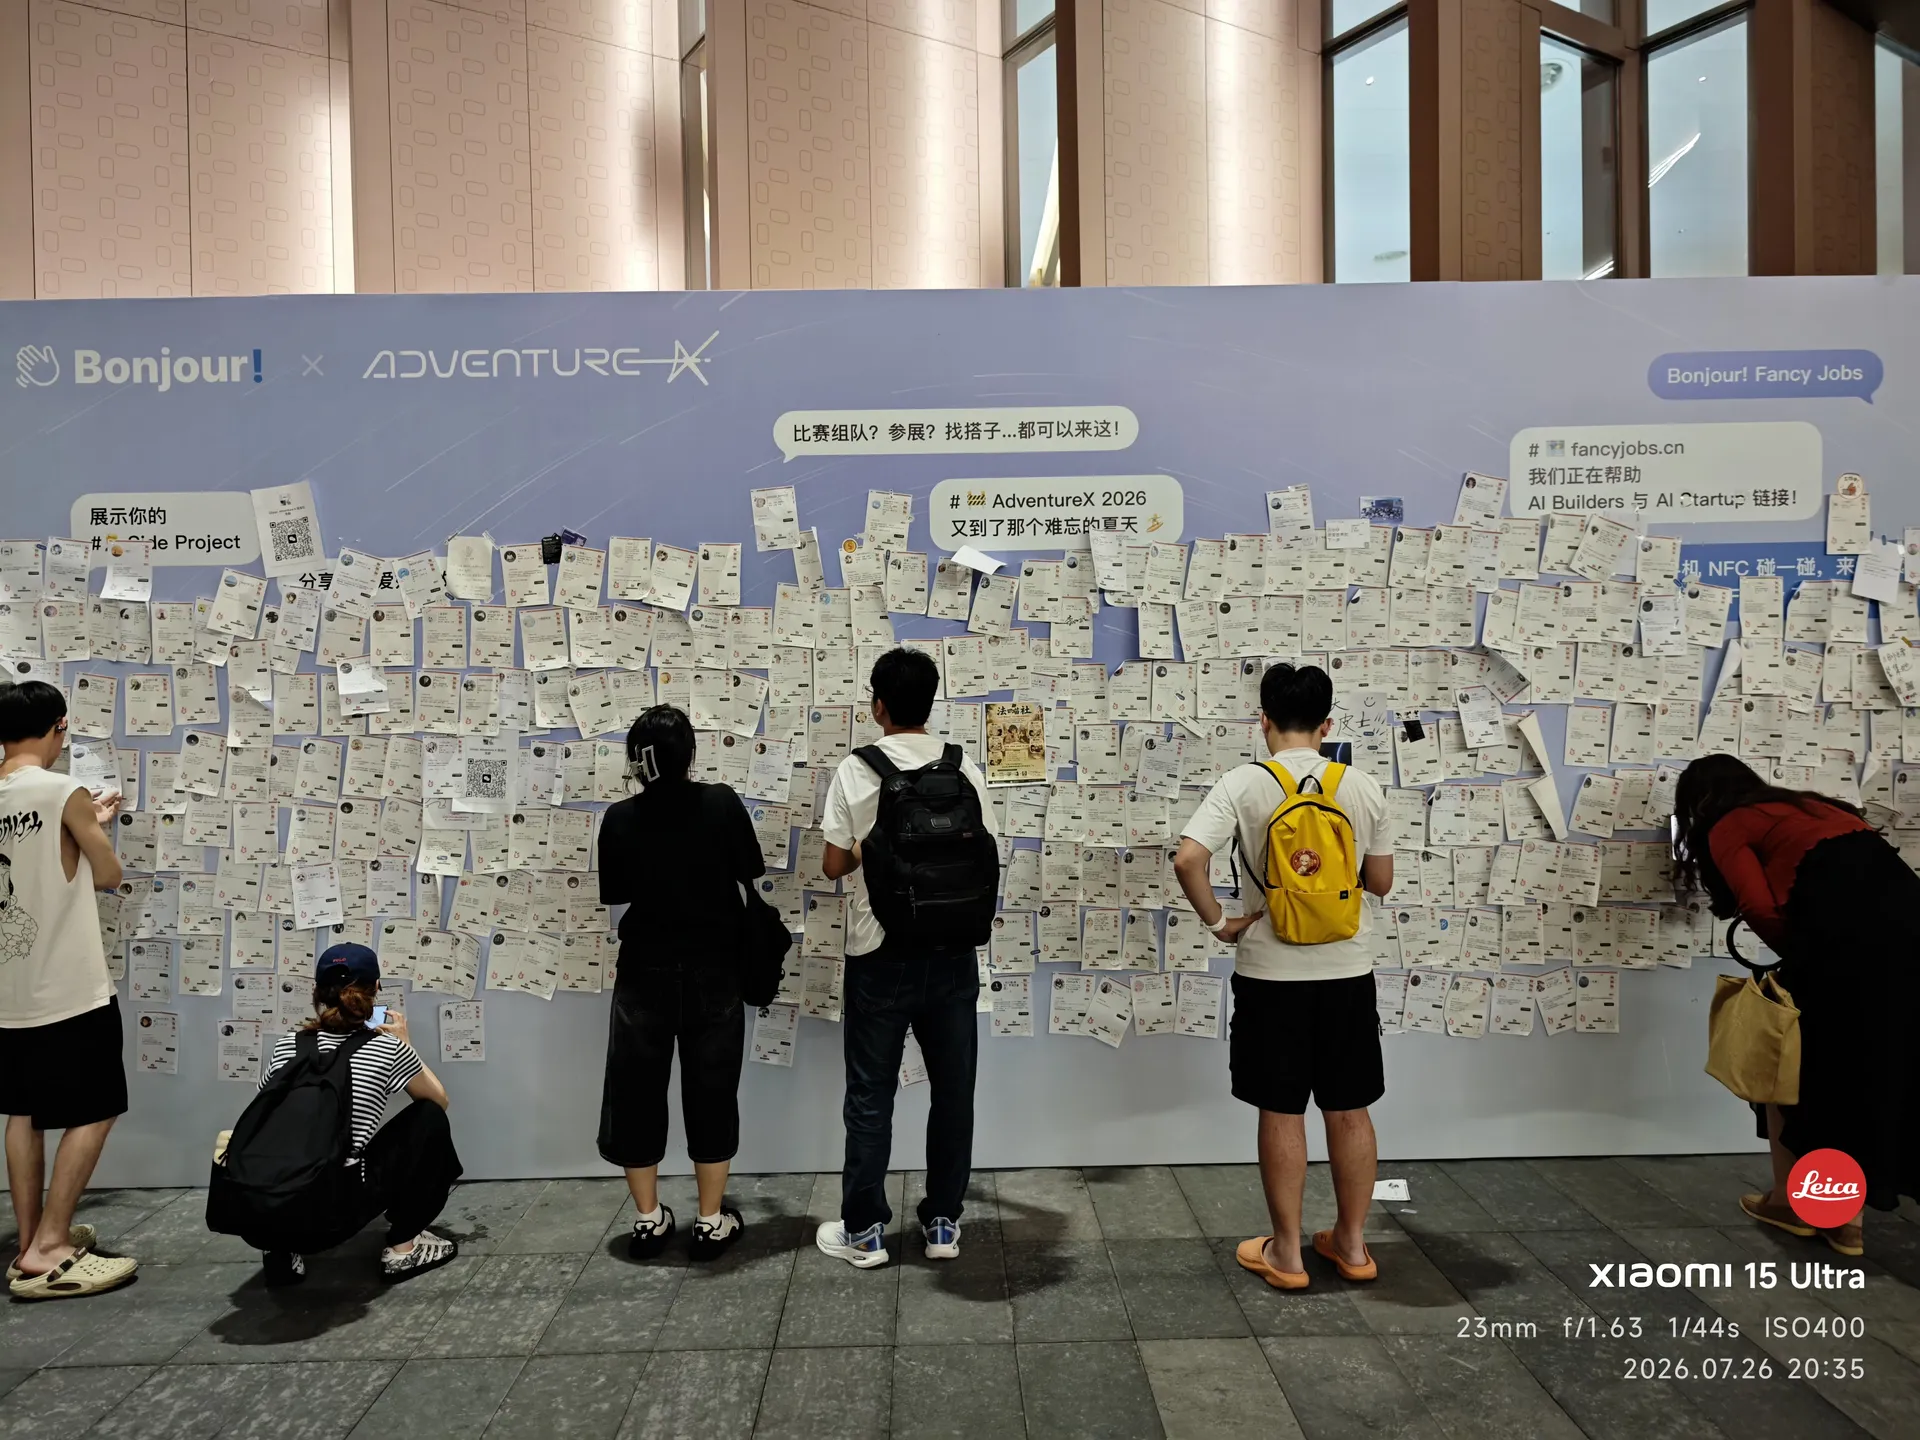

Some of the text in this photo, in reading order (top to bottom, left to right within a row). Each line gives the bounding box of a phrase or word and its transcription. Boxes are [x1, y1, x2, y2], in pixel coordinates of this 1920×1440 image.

[75, 347, 263, 392] Bonjour!
[1668, 364, 1863, 387] Bonjour! Fancy Jobs
[1571, 440, 1685, 460] fancyjobs.cn
[1528, 466, 1641, 486] 我们正在帮助
[992, 491, 1095, 509] AdventureX
[1102, 490, 1147, 507] 2026
[1528, 495, 1545, 510] AI
[1553, 494, 1625, 510] Builders
[1632, 491, 1649, 510] 与
[1657, 492, 1673, 508] AI
[90, 507, 167, 526] 展示你的
[950, 516, 1138, 538] 又到了那个难忘的夏天
[175, 534, 241, 553] Project
[1708, 560, 1749, 577] NFC
